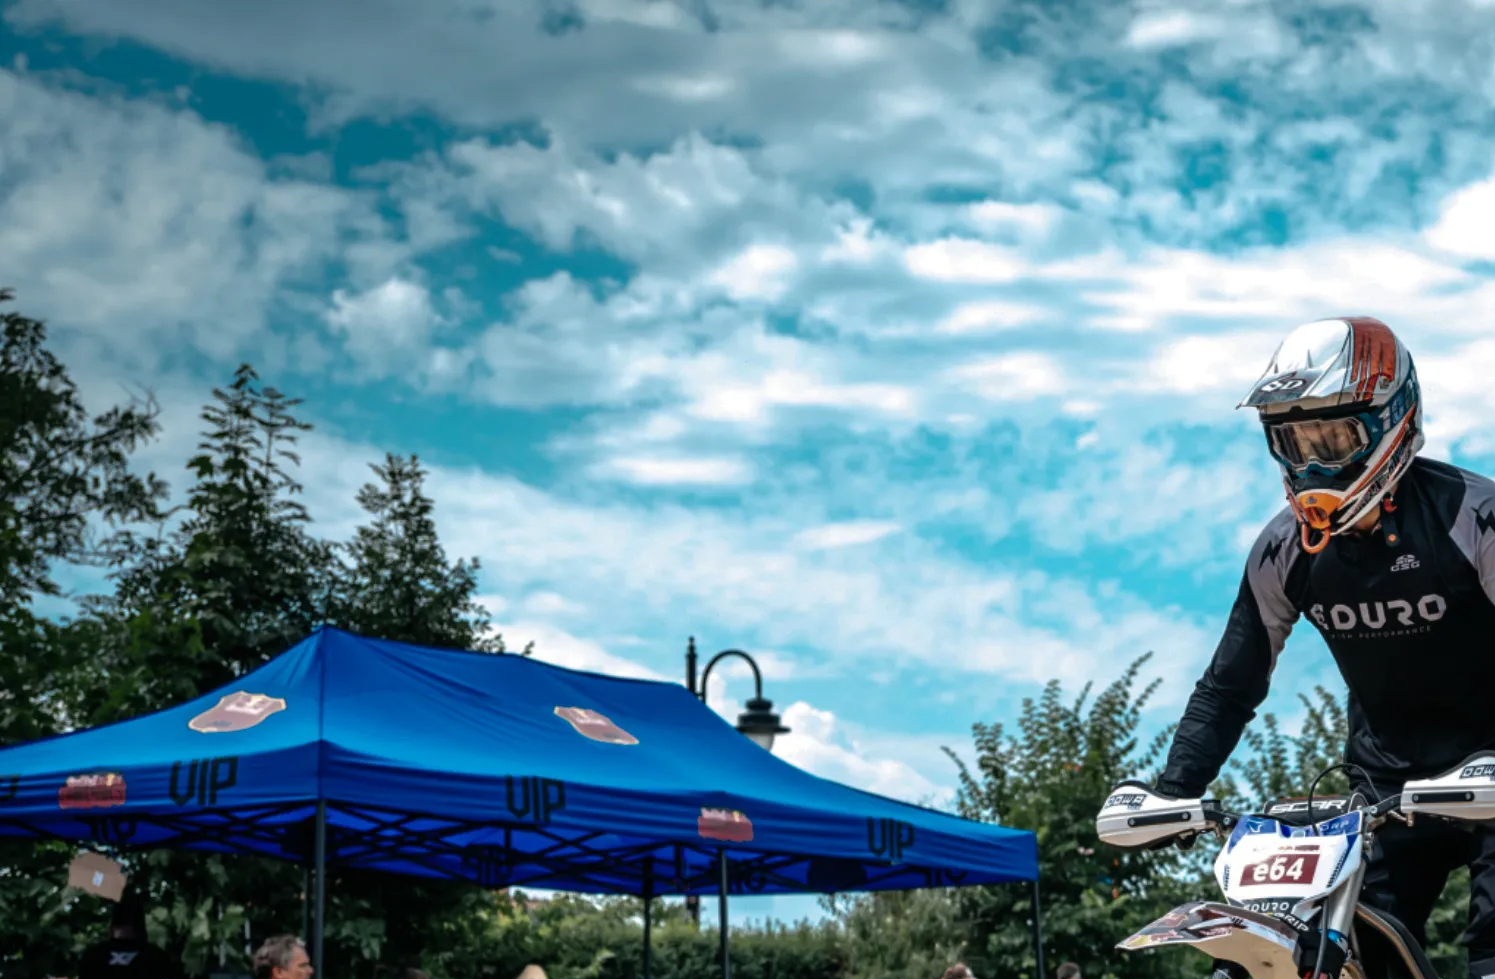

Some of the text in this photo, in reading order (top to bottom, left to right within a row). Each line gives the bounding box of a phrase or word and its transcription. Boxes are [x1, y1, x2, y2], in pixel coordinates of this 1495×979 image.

[169, 756, 239, 807] VIP
[505, 775, 565, 823] VIP
[1269, 799, 1347, 815] SCAR
[866, 816, 914, 861] VIP
[1253, 856, 1304, 882] e64
